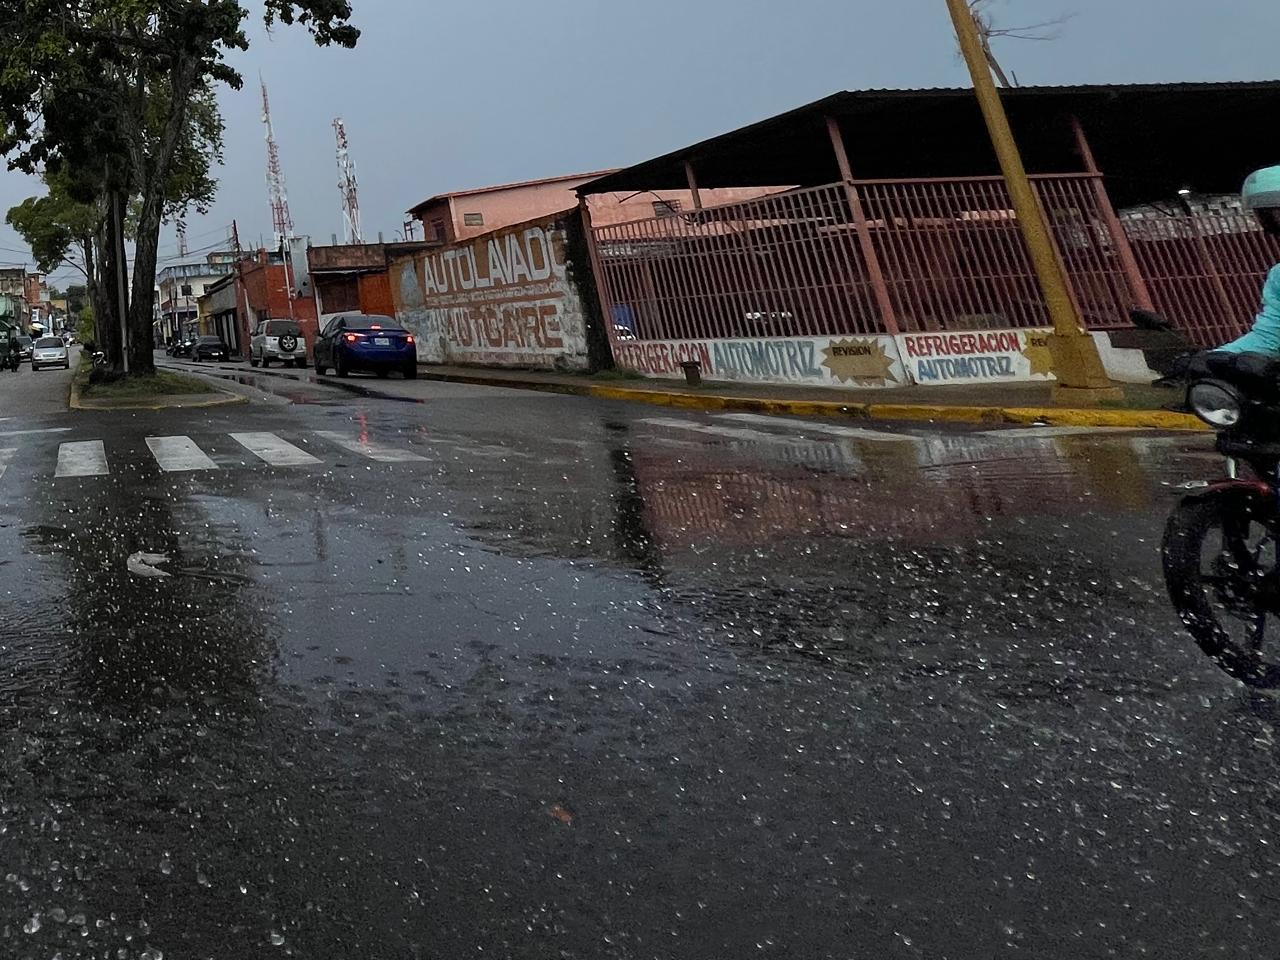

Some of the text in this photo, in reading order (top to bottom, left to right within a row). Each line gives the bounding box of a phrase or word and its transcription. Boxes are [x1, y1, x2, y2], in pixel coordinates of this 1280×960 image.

[832, 346, 871, 357] REVISION
[905, 331, 1022, 358] REFRIGERACION
[713, 340, 823, 379] AUTOMOTRIZ
[917, 355, 1016, 381] AUTOMOTRIZ
